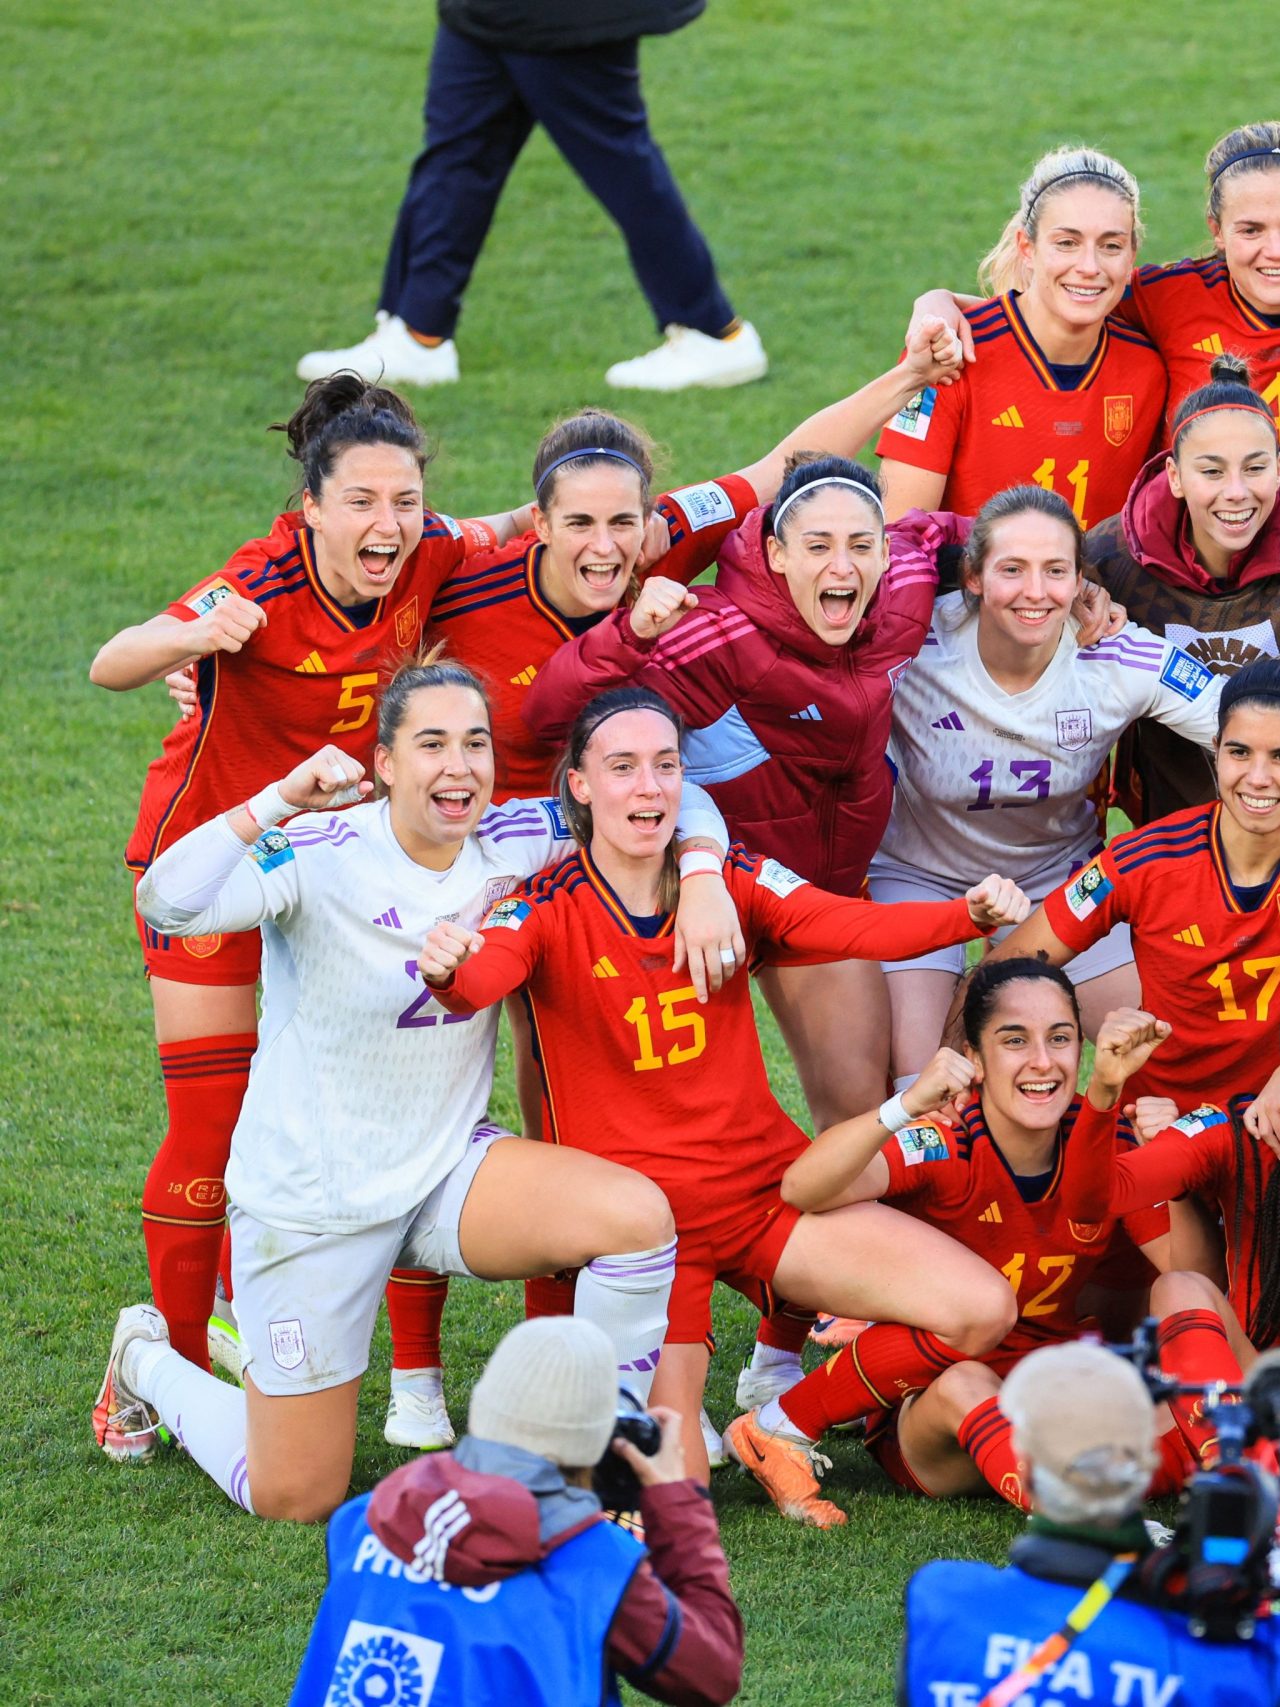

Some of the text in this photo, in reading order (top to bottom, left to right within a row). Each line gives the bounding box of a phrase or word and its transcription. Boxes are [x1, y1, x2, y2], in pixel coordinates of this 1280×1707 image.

[692, 491, 710, 516] UNITES
[329, 672, 378, 734] 5
[1178, 660, 1195, 685] UNITES
[967, 760, 1052, 811] 13
[397, 959, 479, 1029] 2
[623, 985, 706, 1071] 15
[1000, 1252, 1076, 1317] 12
[983, 1632, 1094, 1700] FIA
[1110, 1660, 1184, 1707] TV
